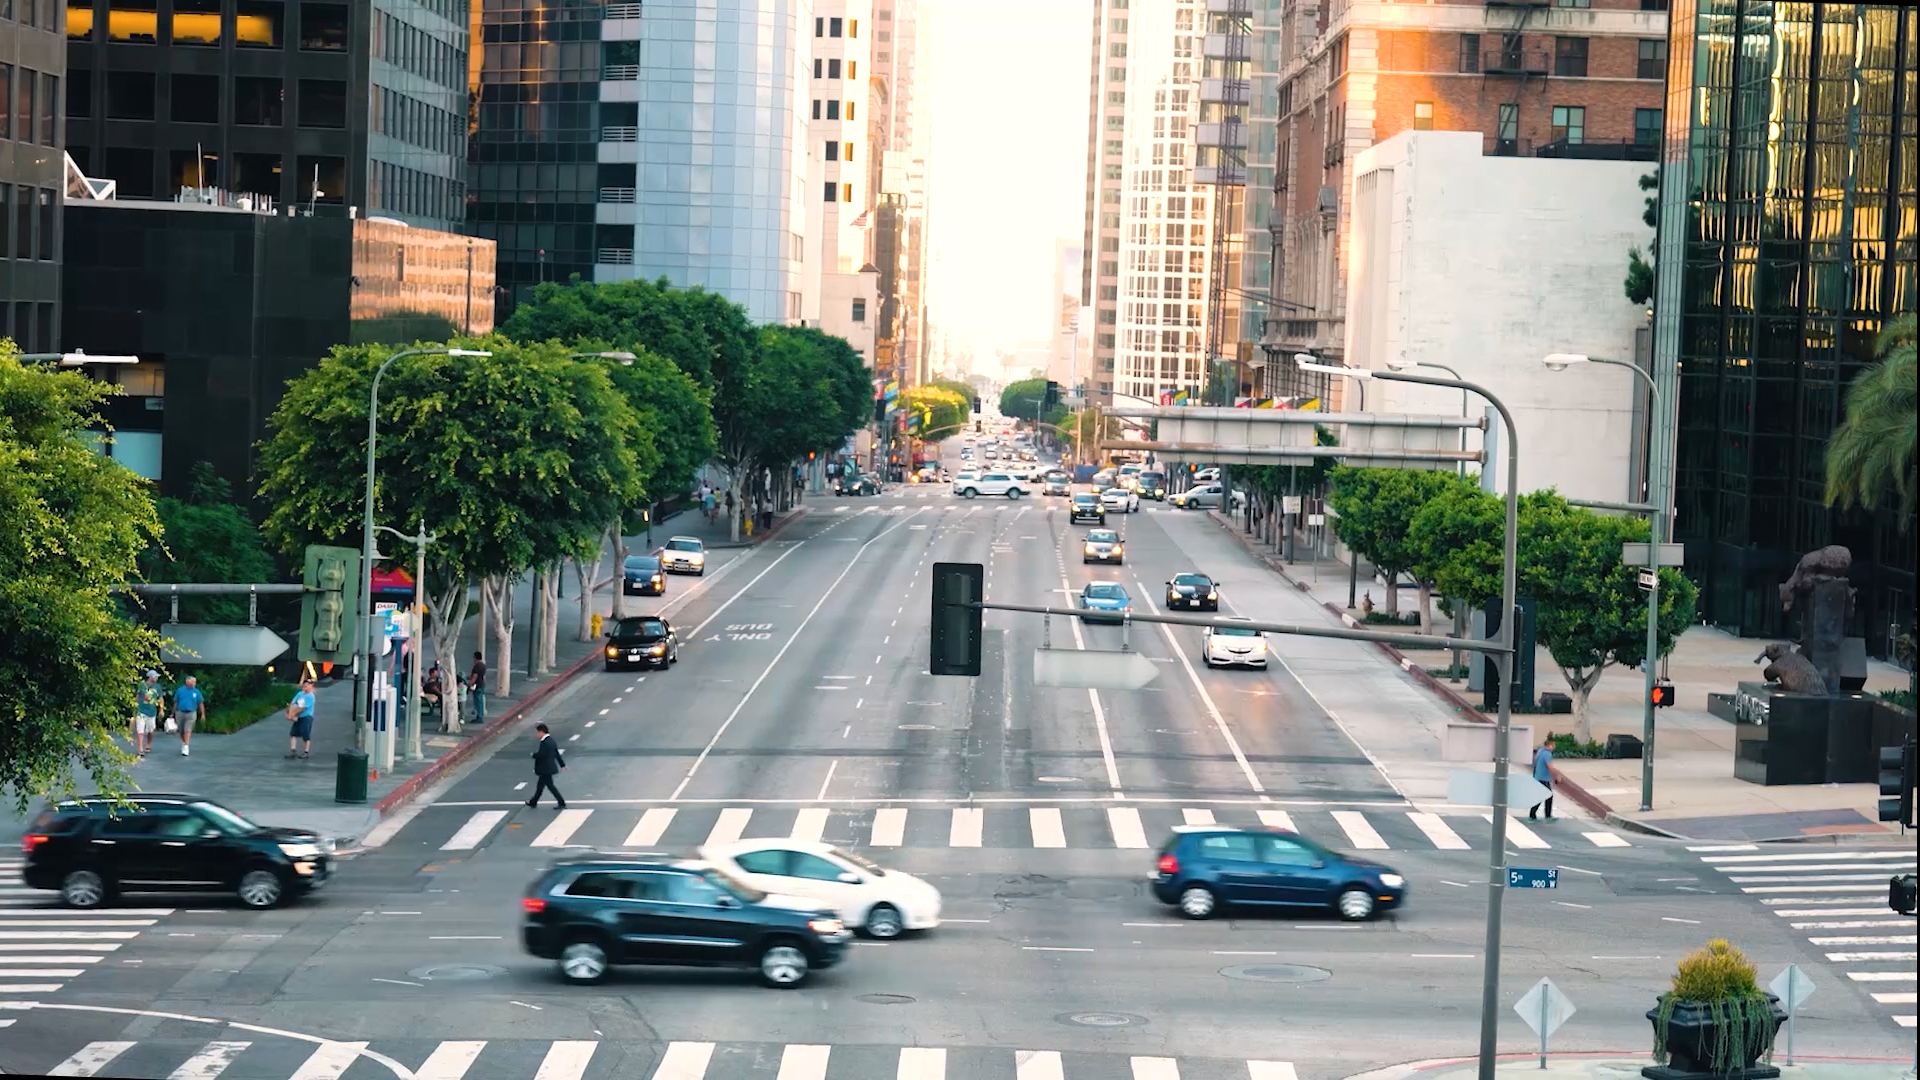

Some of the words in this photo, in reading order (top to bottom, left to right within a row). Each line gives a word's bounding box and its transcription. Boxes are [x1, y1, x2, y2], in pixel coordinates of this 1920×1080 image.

[704, 633, 772, 641] ONLY
[1548, 870, 1556, 878] St
[1531, 880, 1546, 888] 900
[1549, 880, 1556, 888] W
